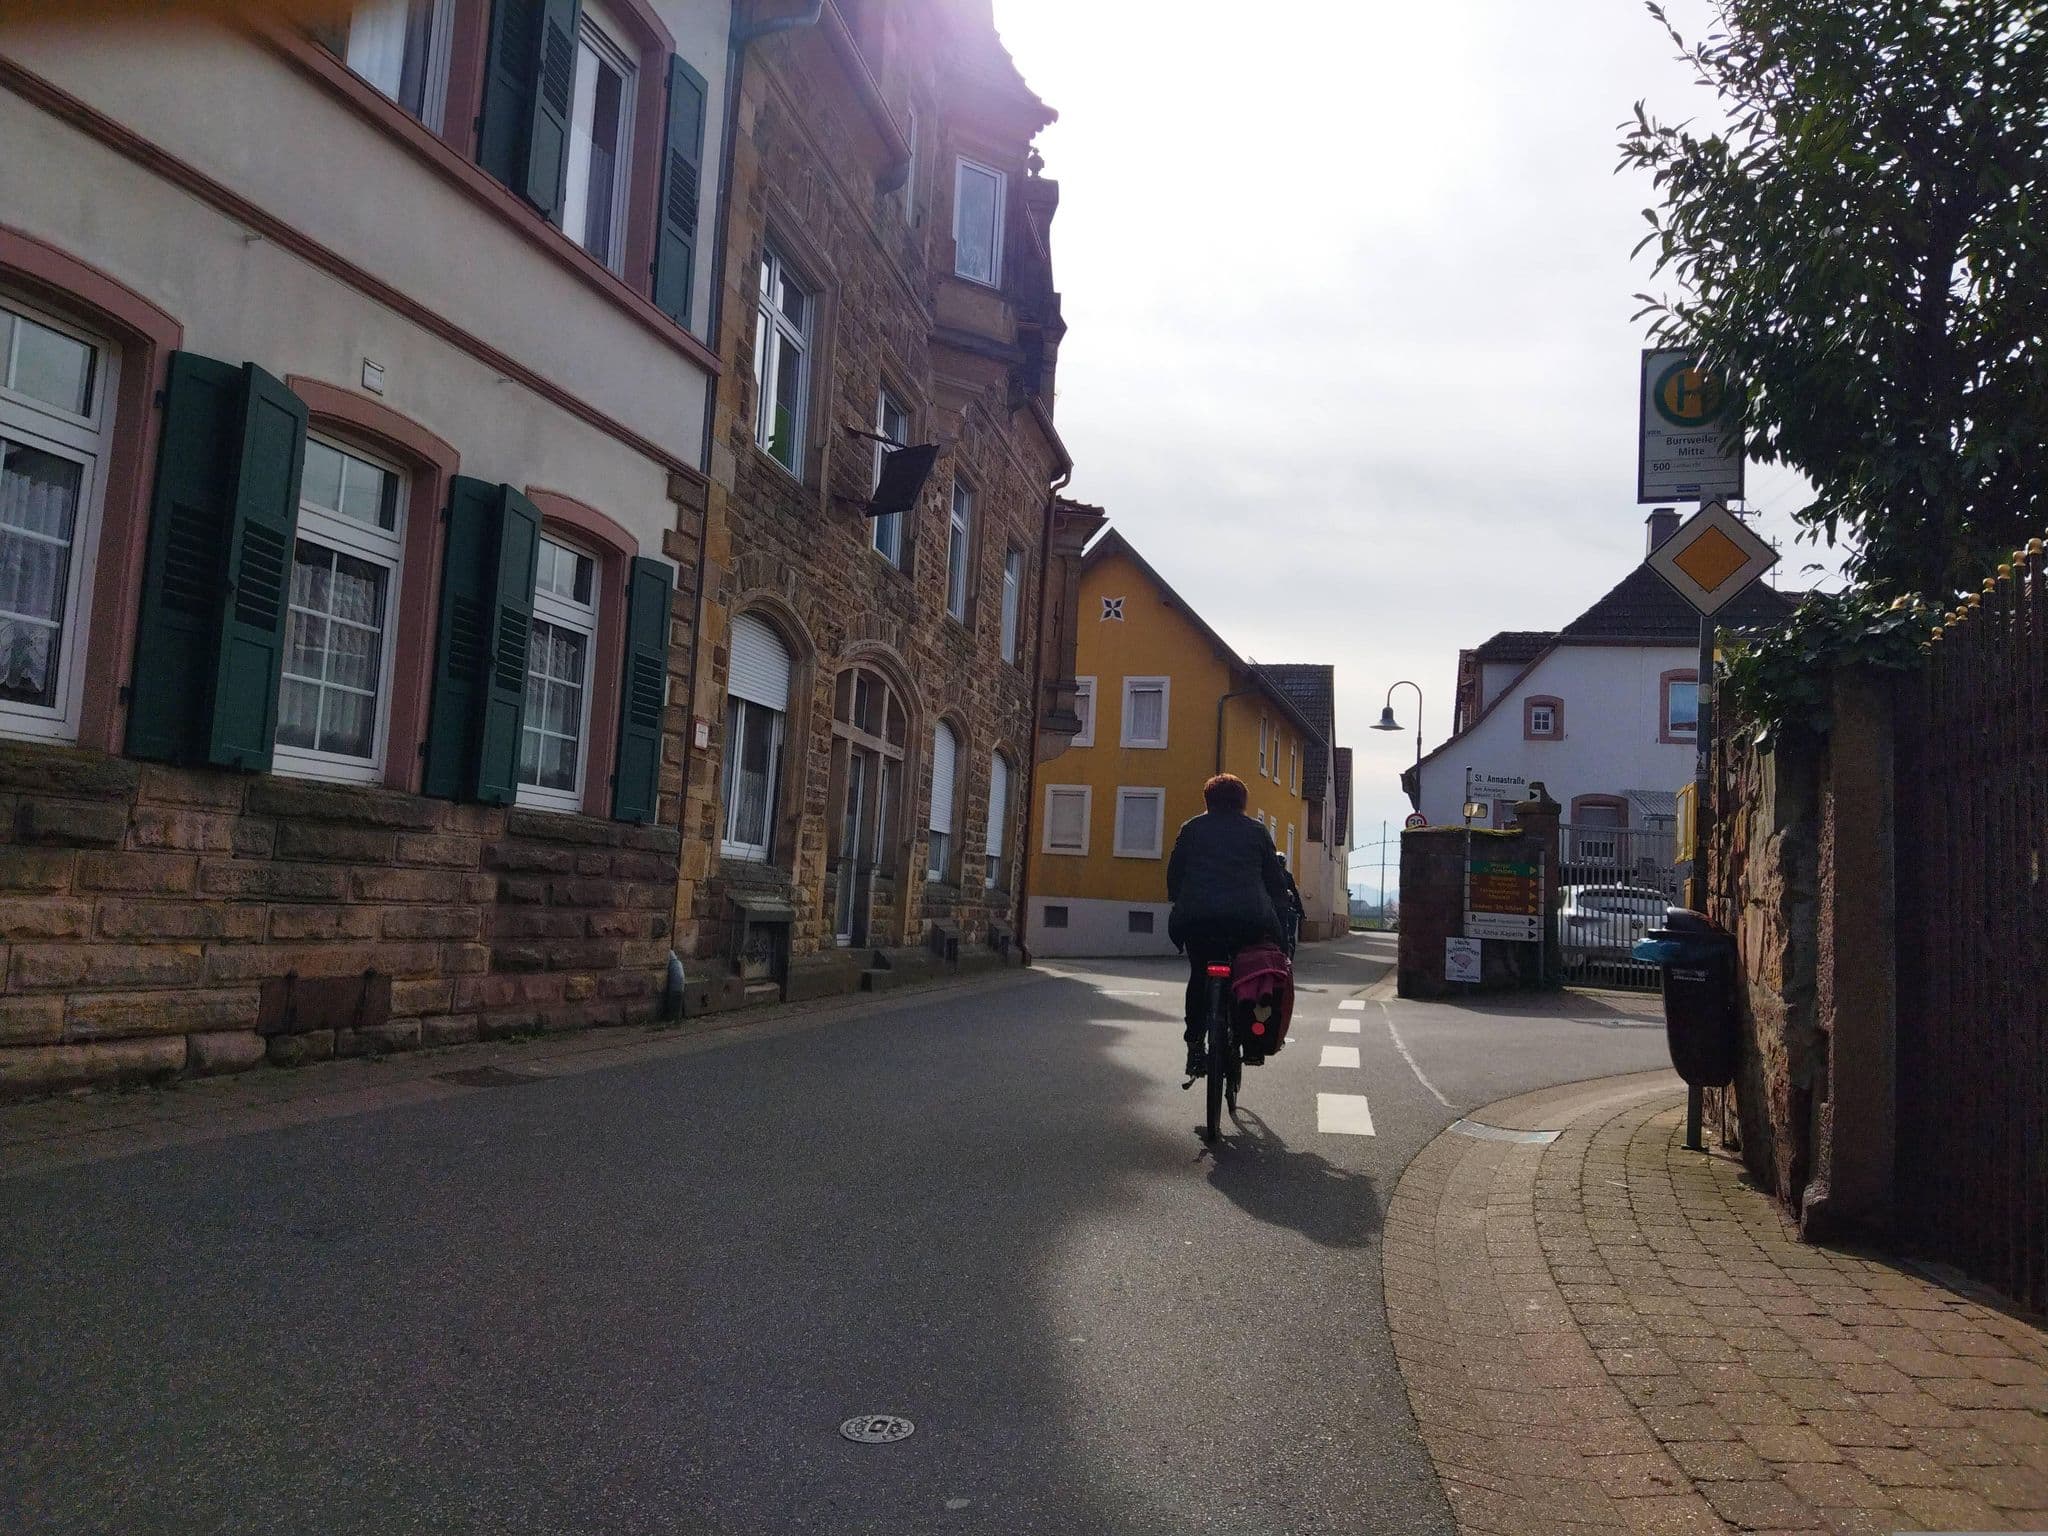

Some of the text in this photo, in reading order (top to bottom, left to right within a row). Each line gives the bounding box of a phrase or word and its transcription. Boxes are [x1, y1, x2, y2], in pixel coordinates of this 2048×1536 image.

[1666, 434, 1718, 446] Burrweiler
[1678, 447, 1705, 457] Mitte
[1653, 462, 1671, 472] 500
[1487, 775, 1526, 786] Annastraße
